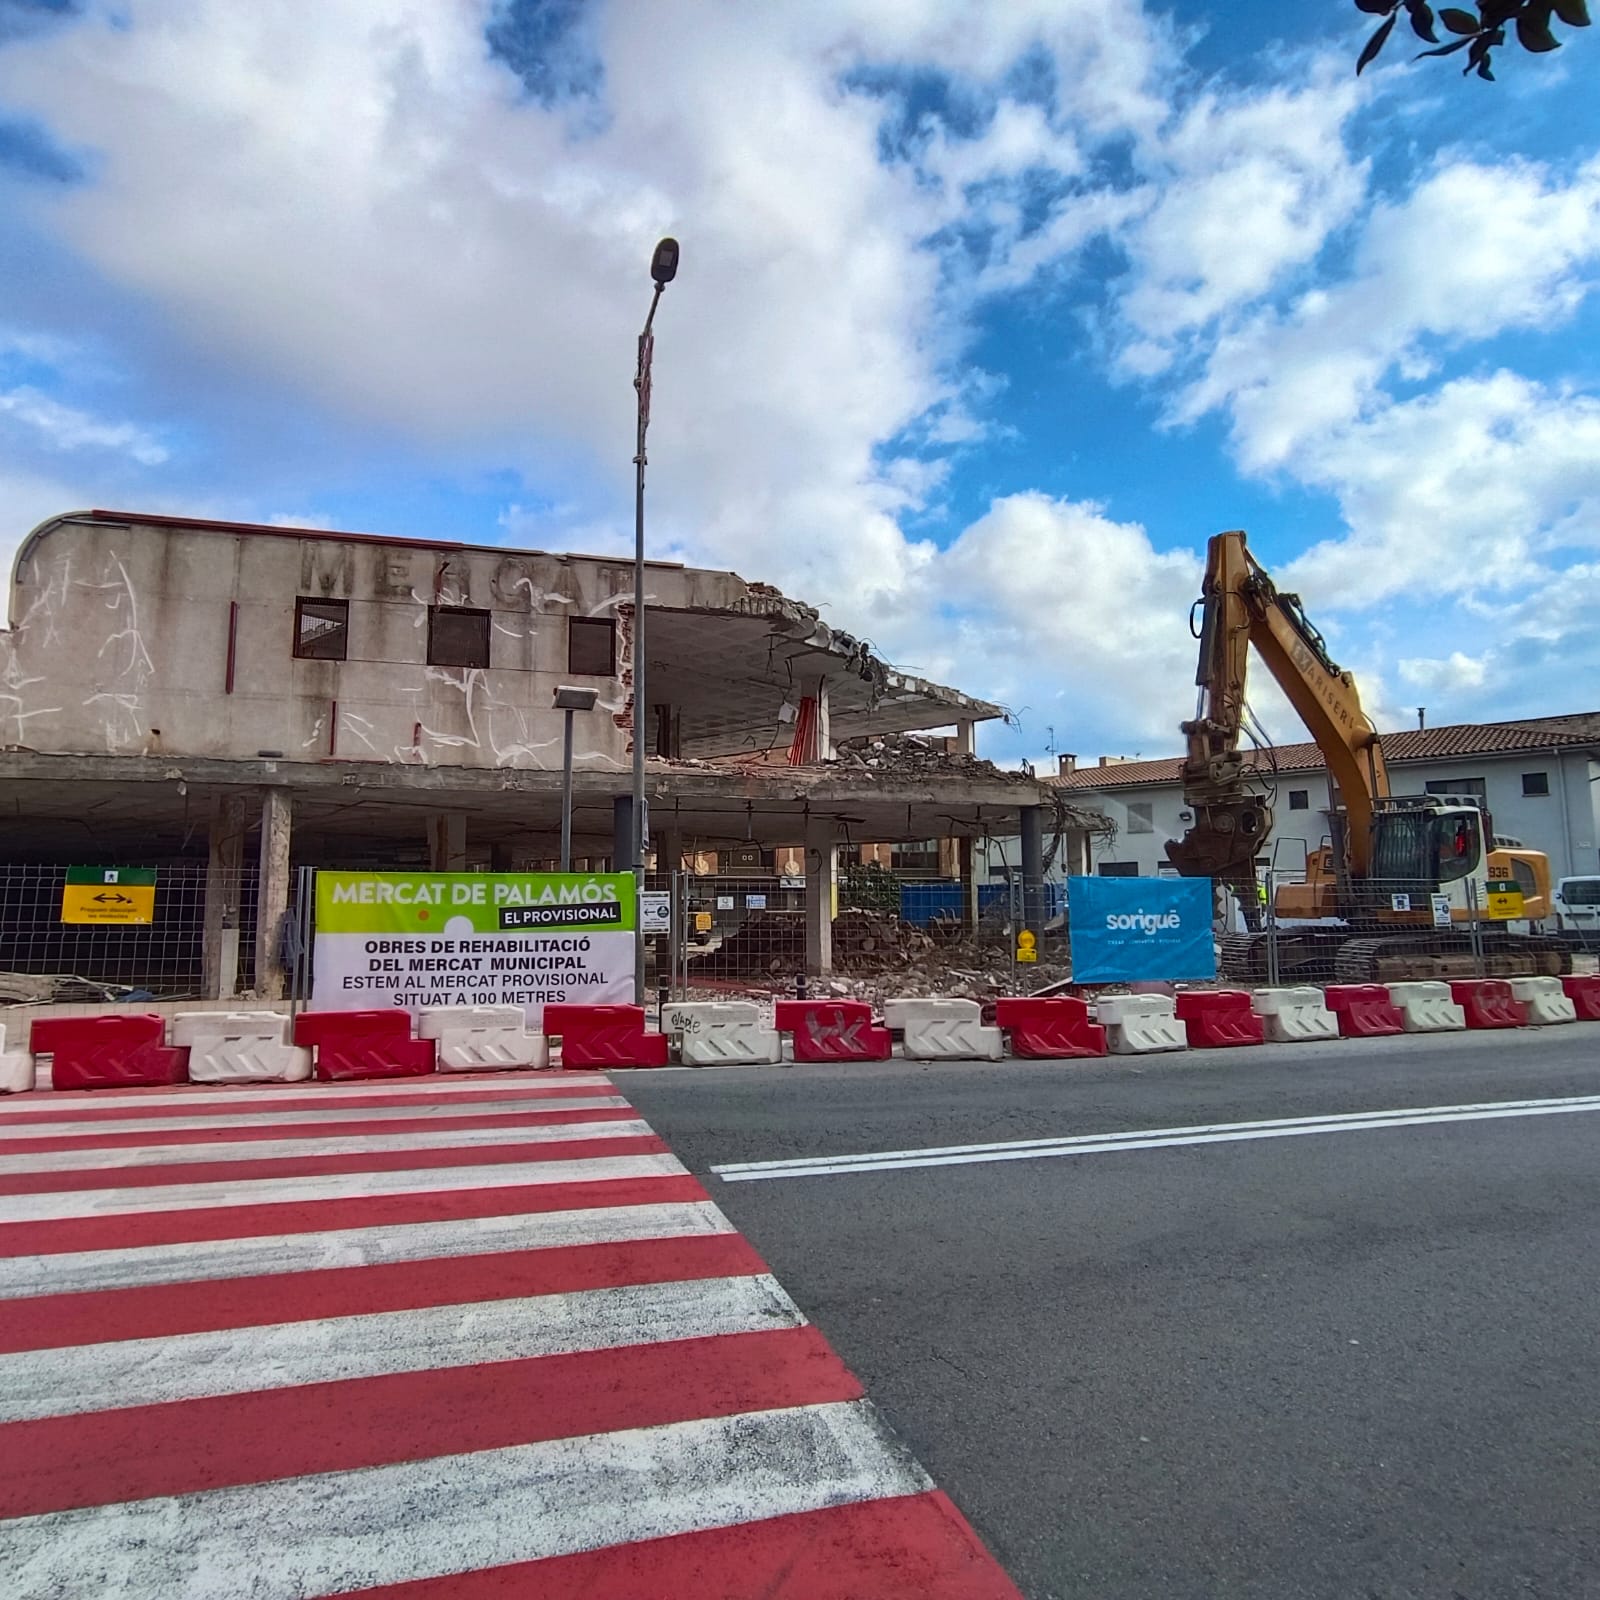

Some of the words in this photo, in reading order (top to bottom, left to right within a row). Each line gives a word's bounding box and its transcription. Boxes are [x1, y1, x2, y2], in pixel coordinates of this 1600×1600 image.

[1488, 867, 1509, 878] 936
[332, 882, 446, 905] MERCAT
[452, 883, 487, 905] DE
[494, 878, 617, 905] PALAMÓS
[504, 912, 521, 924] EL
[523, 907, 617, 923] PROVISIONAL
[365, 940, 426, 954] OBRES
[431, 940, 455, 954] DE
[459, 935, 591, 954] REHABILITACIÓ
[369, 958, 405, 972] DEL
[409, 957, 483, 972] MERCAT
[490, 956, 587, 971] MUNICIPAL
[343, 975, 399, 990] ESTEM
[404, 975, 426, 989] AL
[430, 974, 498, 989] MERCAT
[502, 971, 609, 987] PROVISIONAL
[393, 992, 452, 1006] SITUAT
[455, 992, 467, 1005] A
[471, 992, 497, 1005] 100
[501, 990, 566, 1004] METRES
